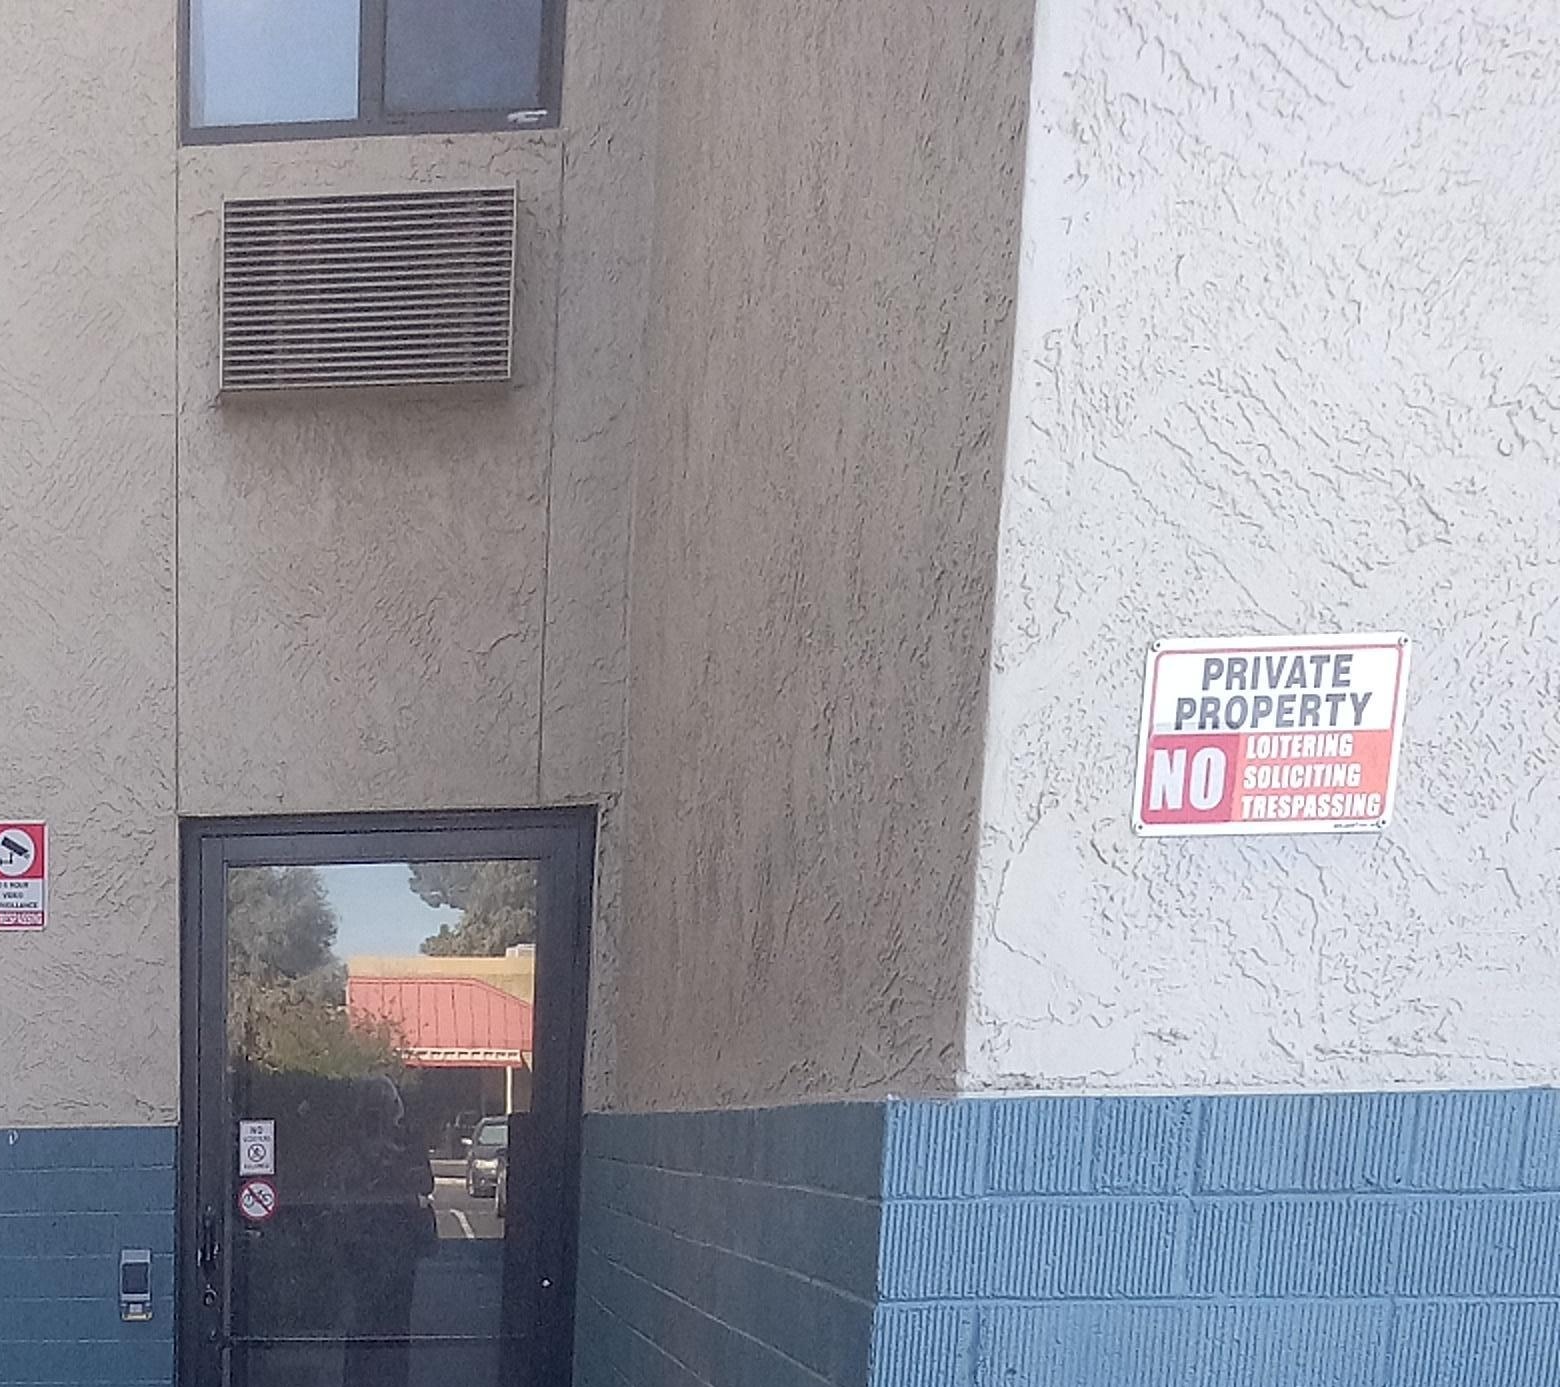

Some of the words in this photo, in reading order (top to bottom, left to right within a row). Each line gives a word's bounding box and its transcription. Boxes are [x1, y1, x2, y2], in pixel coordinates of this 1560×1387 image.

[1202, 653, 1354, 691] PRIVATE
[1175, 692, 1373, 730] PROPERTY
[1246, 733, 1354, 759] LOITERING
[1148, 747, 1227, 811] NO
[1243, 763, 1362, 789] SOLICITING
[1241, 793, 1382, 819] TRESPASSING
[249, 1125, 263, 1135] NO
